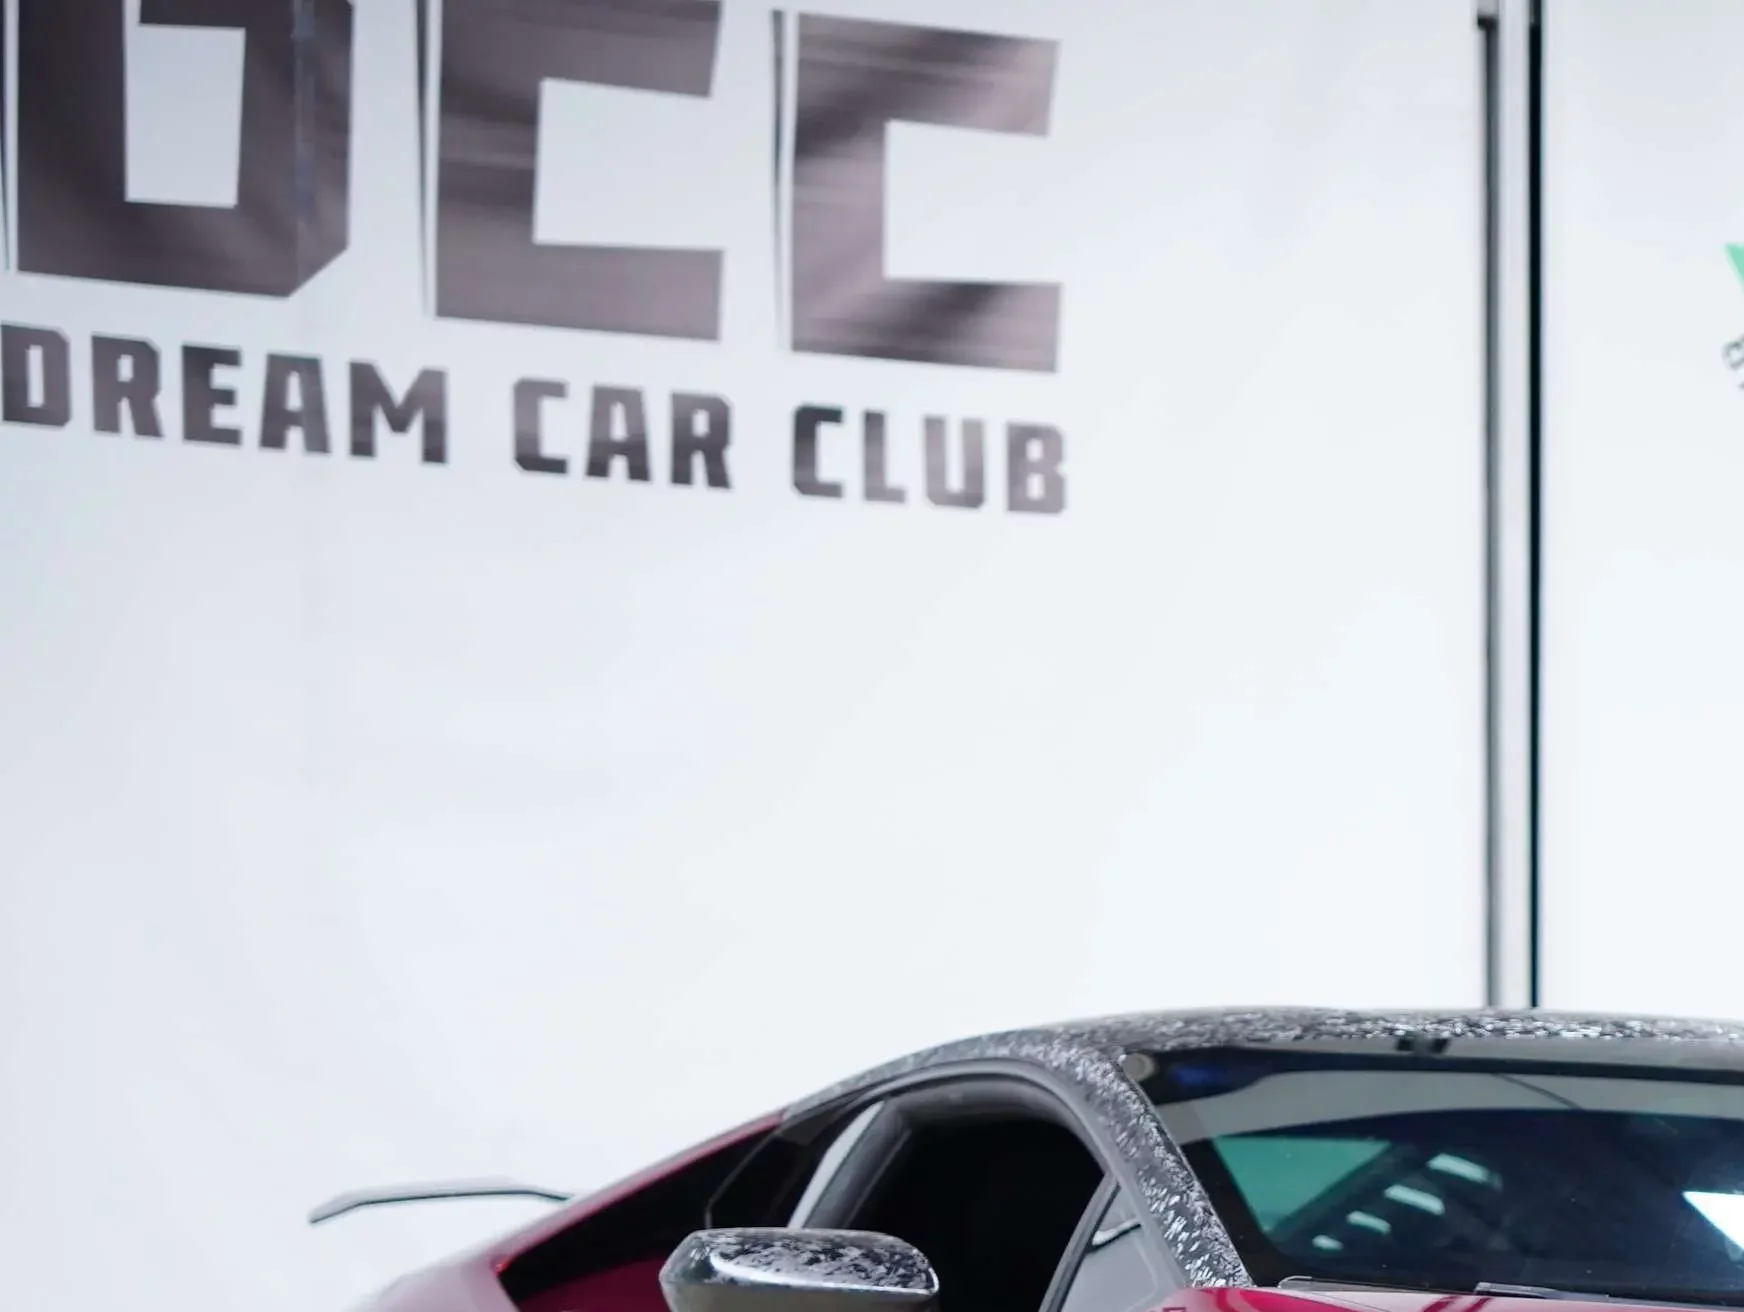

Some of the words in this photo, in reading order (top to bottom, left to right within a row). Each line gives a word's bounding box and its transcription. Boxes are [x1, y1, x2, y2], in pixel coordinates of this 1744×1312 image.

[0, 0, 1062, 372] DCC
[0, 323, 448, 466] DREAM
[512, 376, 734, 491] CAR
[791, 404, 1067, 516] CLUB
